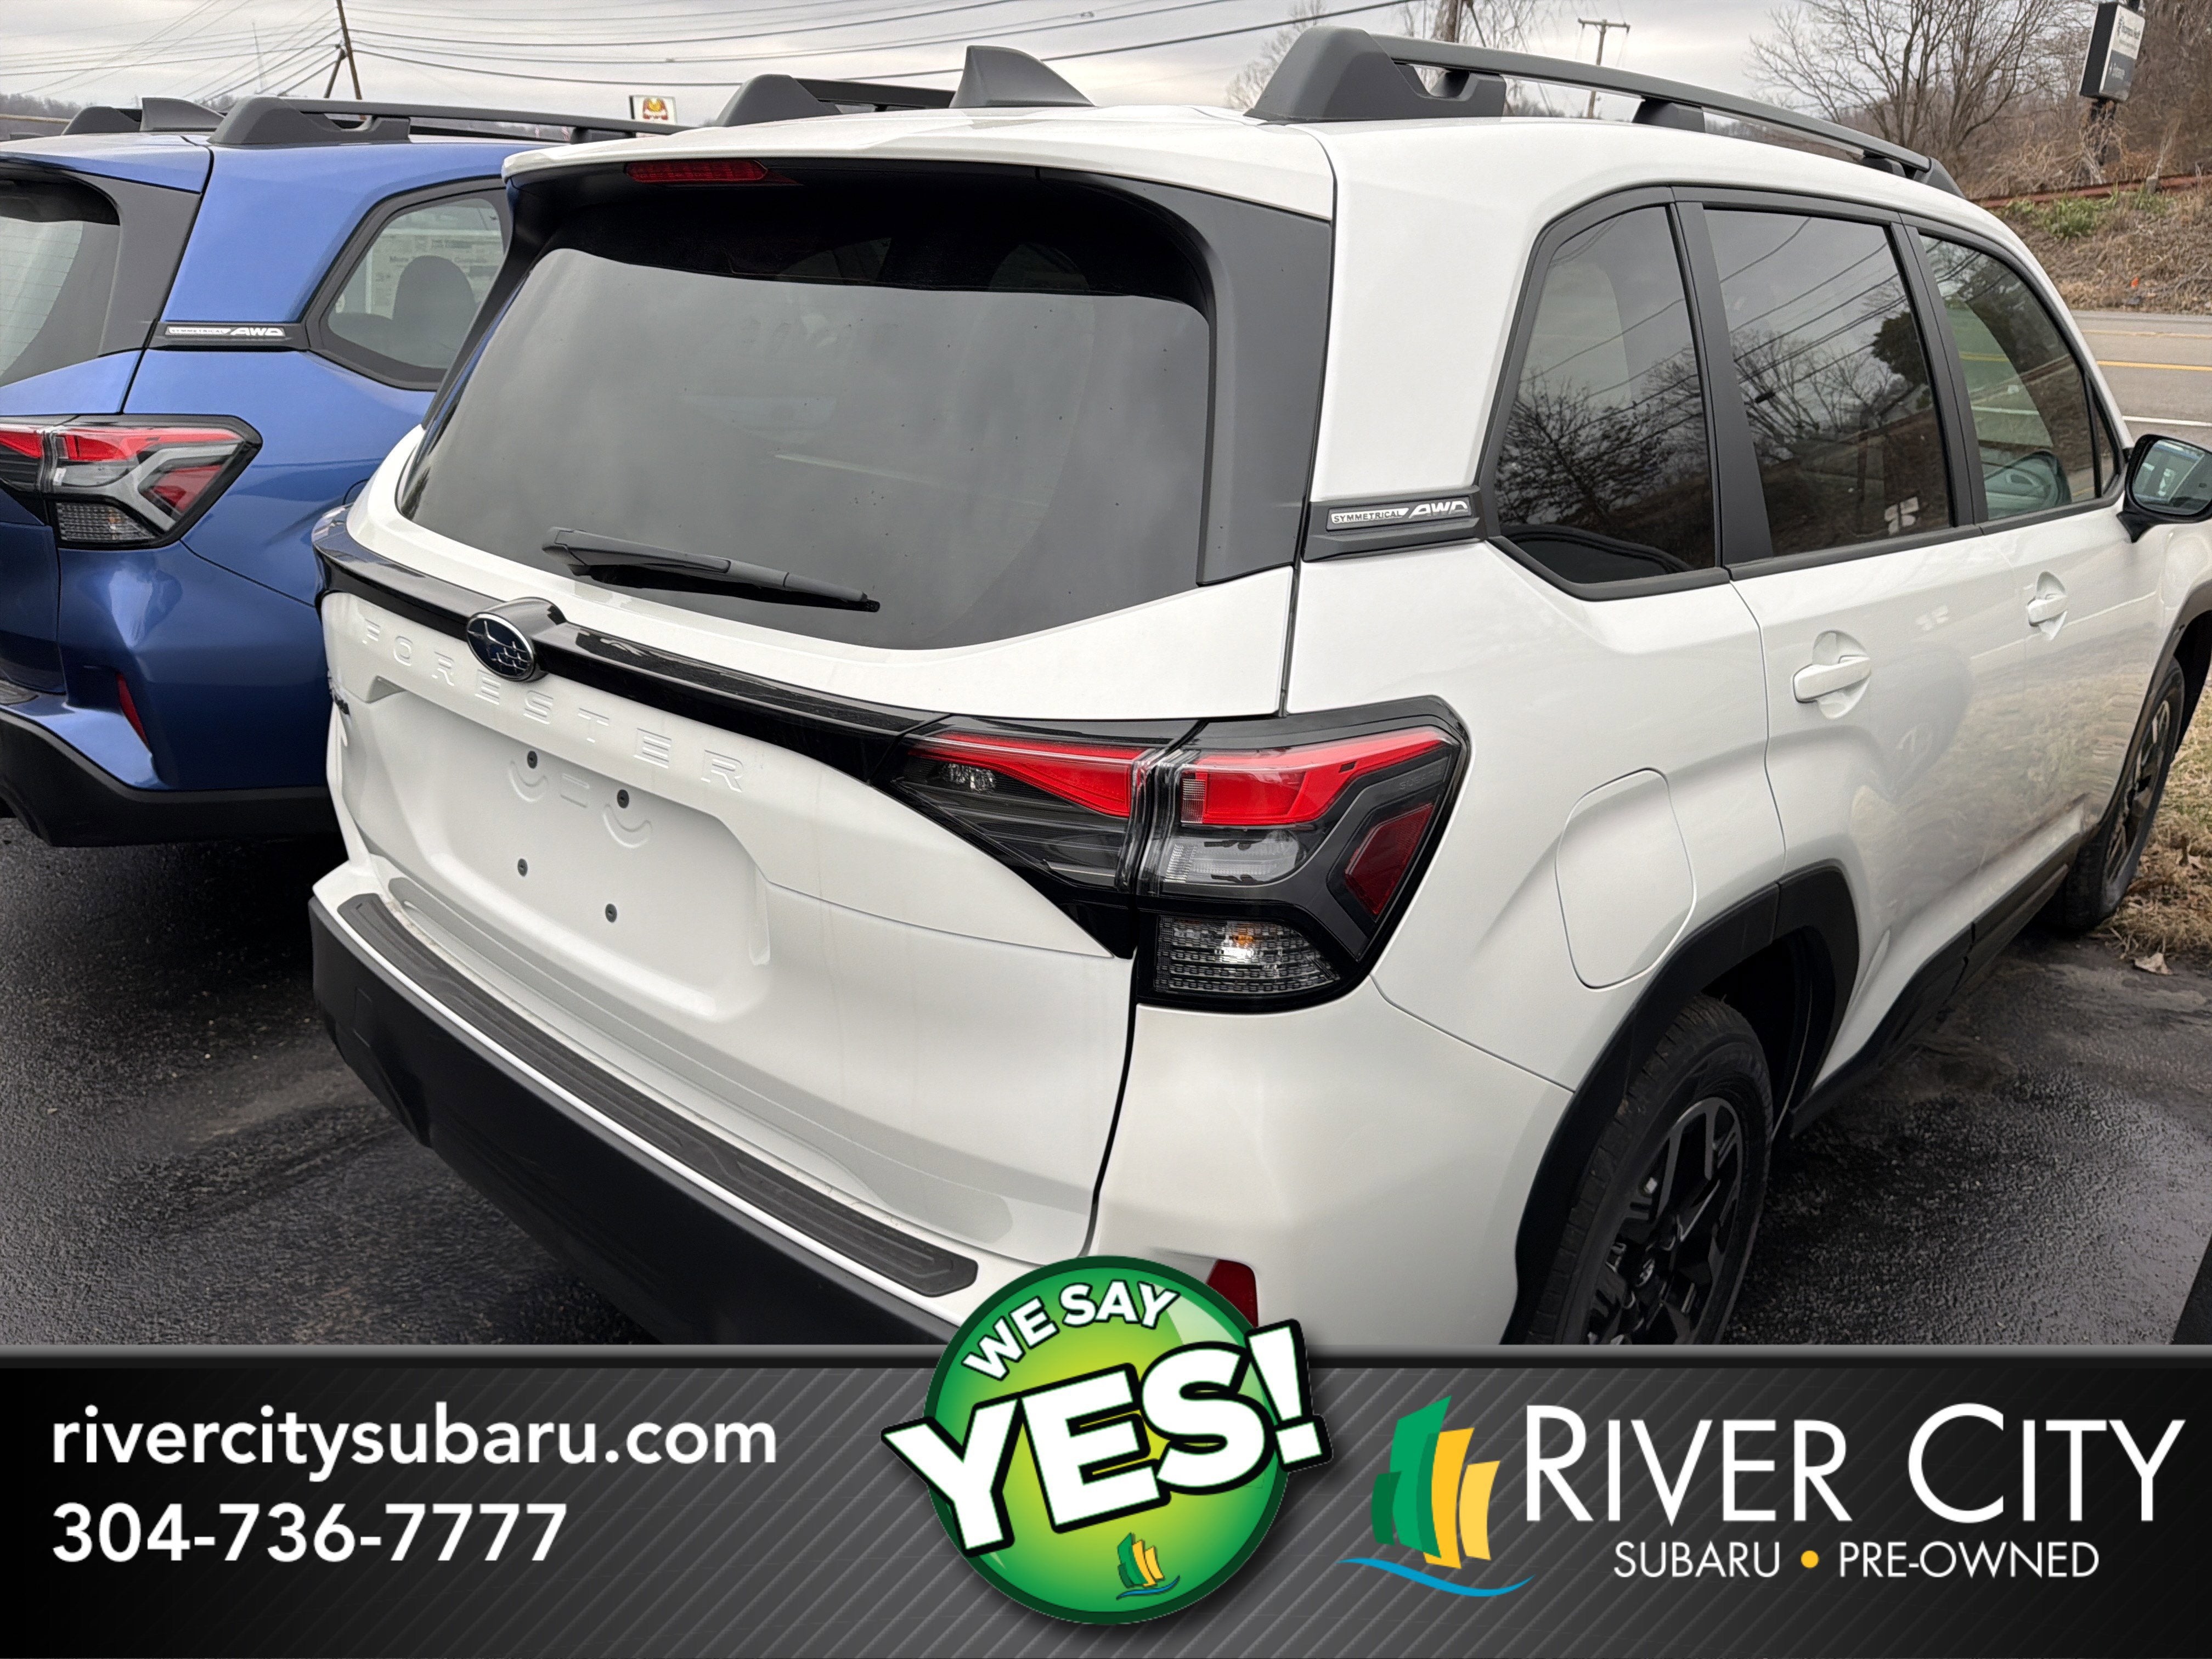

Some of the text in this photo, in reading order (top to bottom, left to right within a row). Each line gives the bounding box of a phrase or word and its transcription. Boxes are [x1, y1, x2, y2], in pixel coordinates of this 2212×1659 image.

[230, 328, 284, 336] AWD
[1333, 500, 1469, 523] SYMMETRICAL AWD
[360, 616, 744, 793] FORESTER
